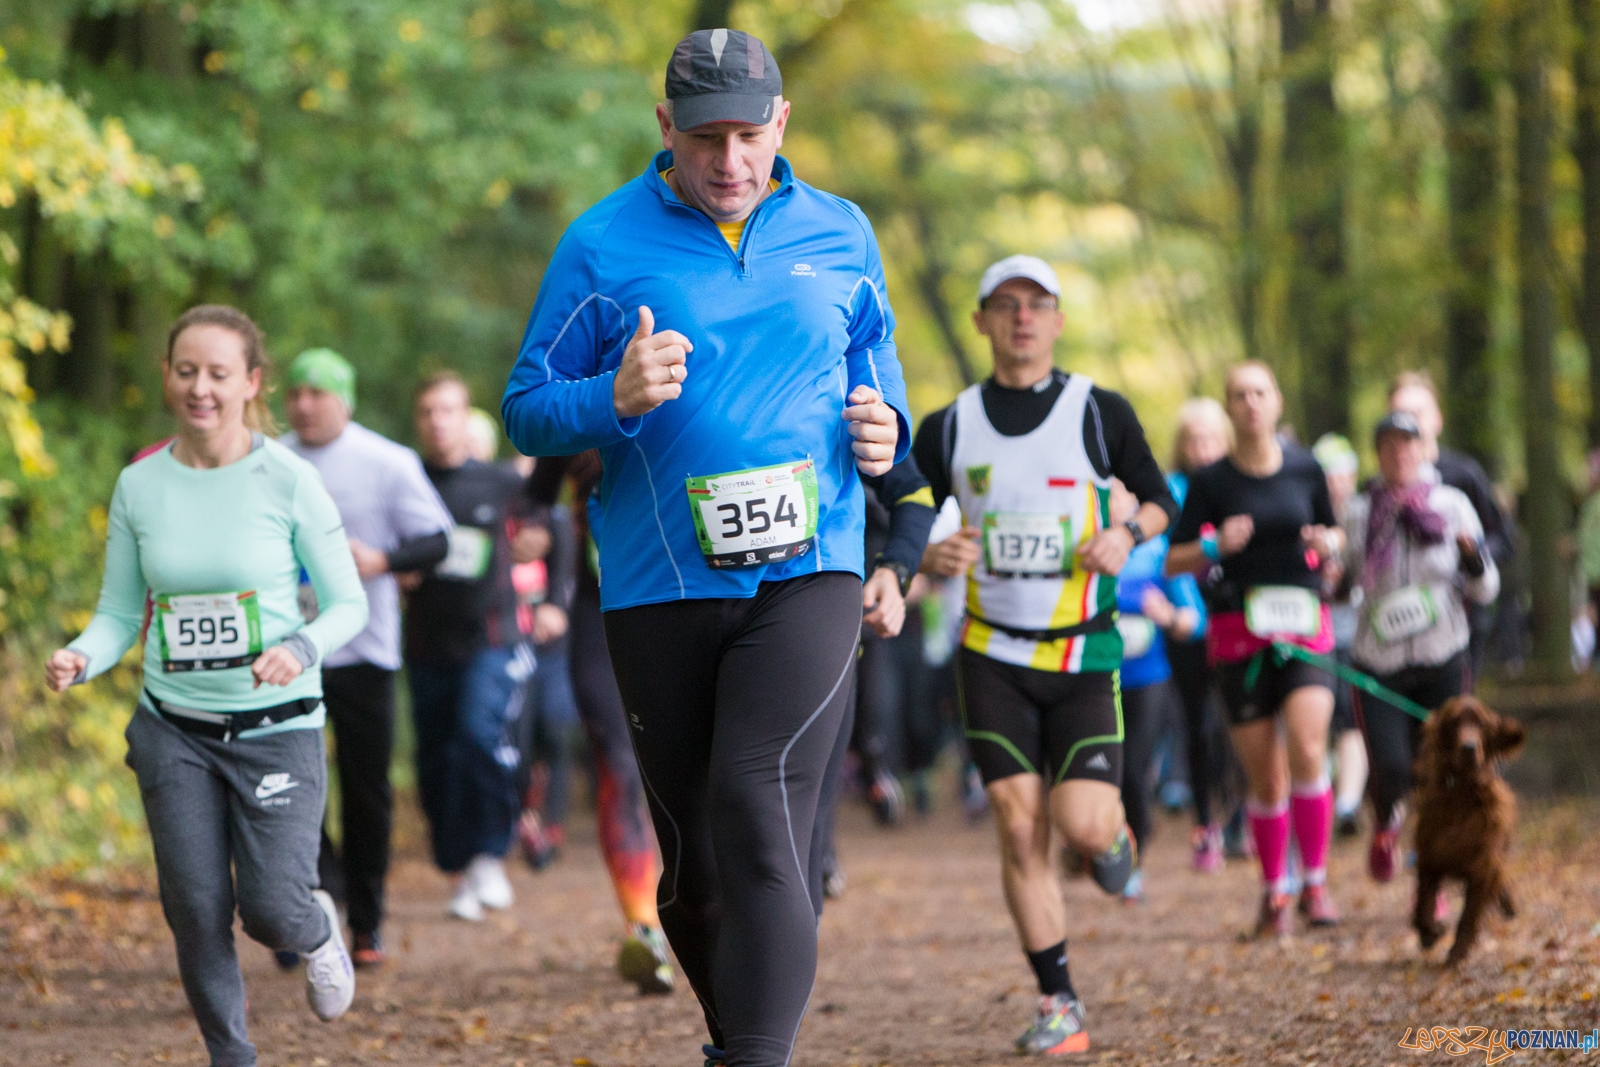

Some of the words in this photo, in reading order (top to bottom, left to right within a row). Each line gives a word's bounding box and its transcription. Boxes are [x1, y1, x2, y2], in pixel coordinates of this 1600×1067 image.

[717, 494, 798, 538] 354
[749, 536, 778, 548] ADAM
[998, 534, 1060, 559] 1375
[178, 616, 239, 646] 595
